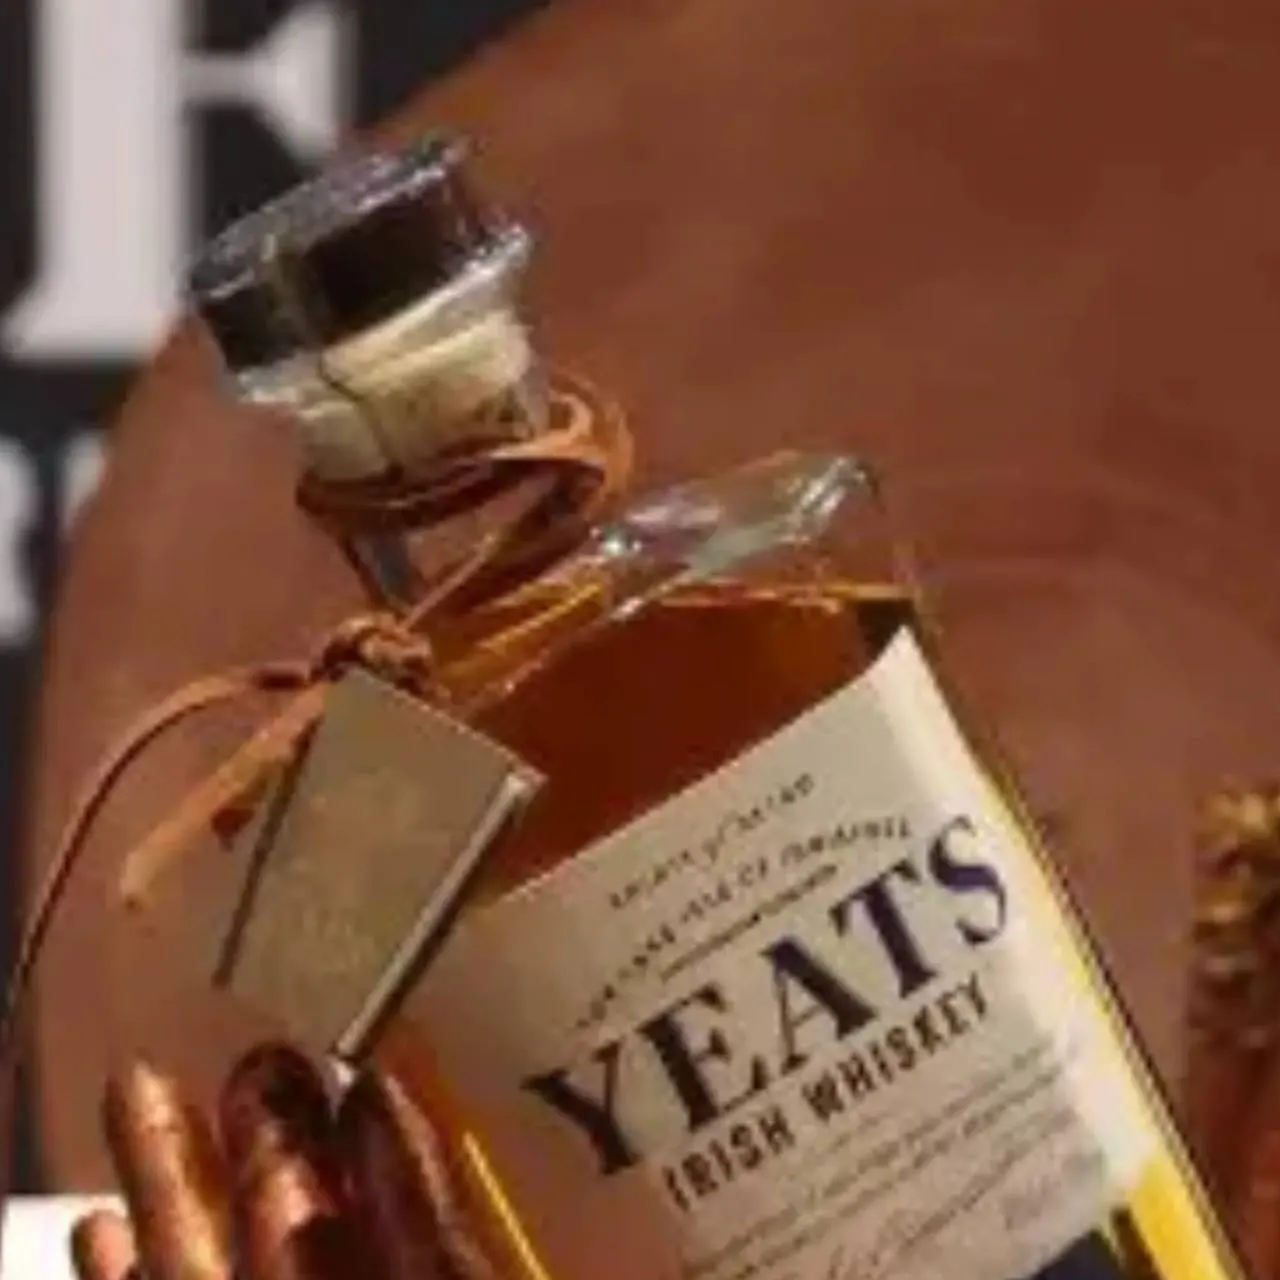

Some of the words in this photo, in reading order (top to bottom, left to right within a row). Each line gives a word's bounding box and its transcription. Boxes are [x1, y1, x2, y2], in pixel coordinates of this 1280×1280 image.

[521, 812, 1008, 1178] YEATS
[662, 1103, 797, 1213] IRISH
[800, 970, 988, 1122] WHISKEY
